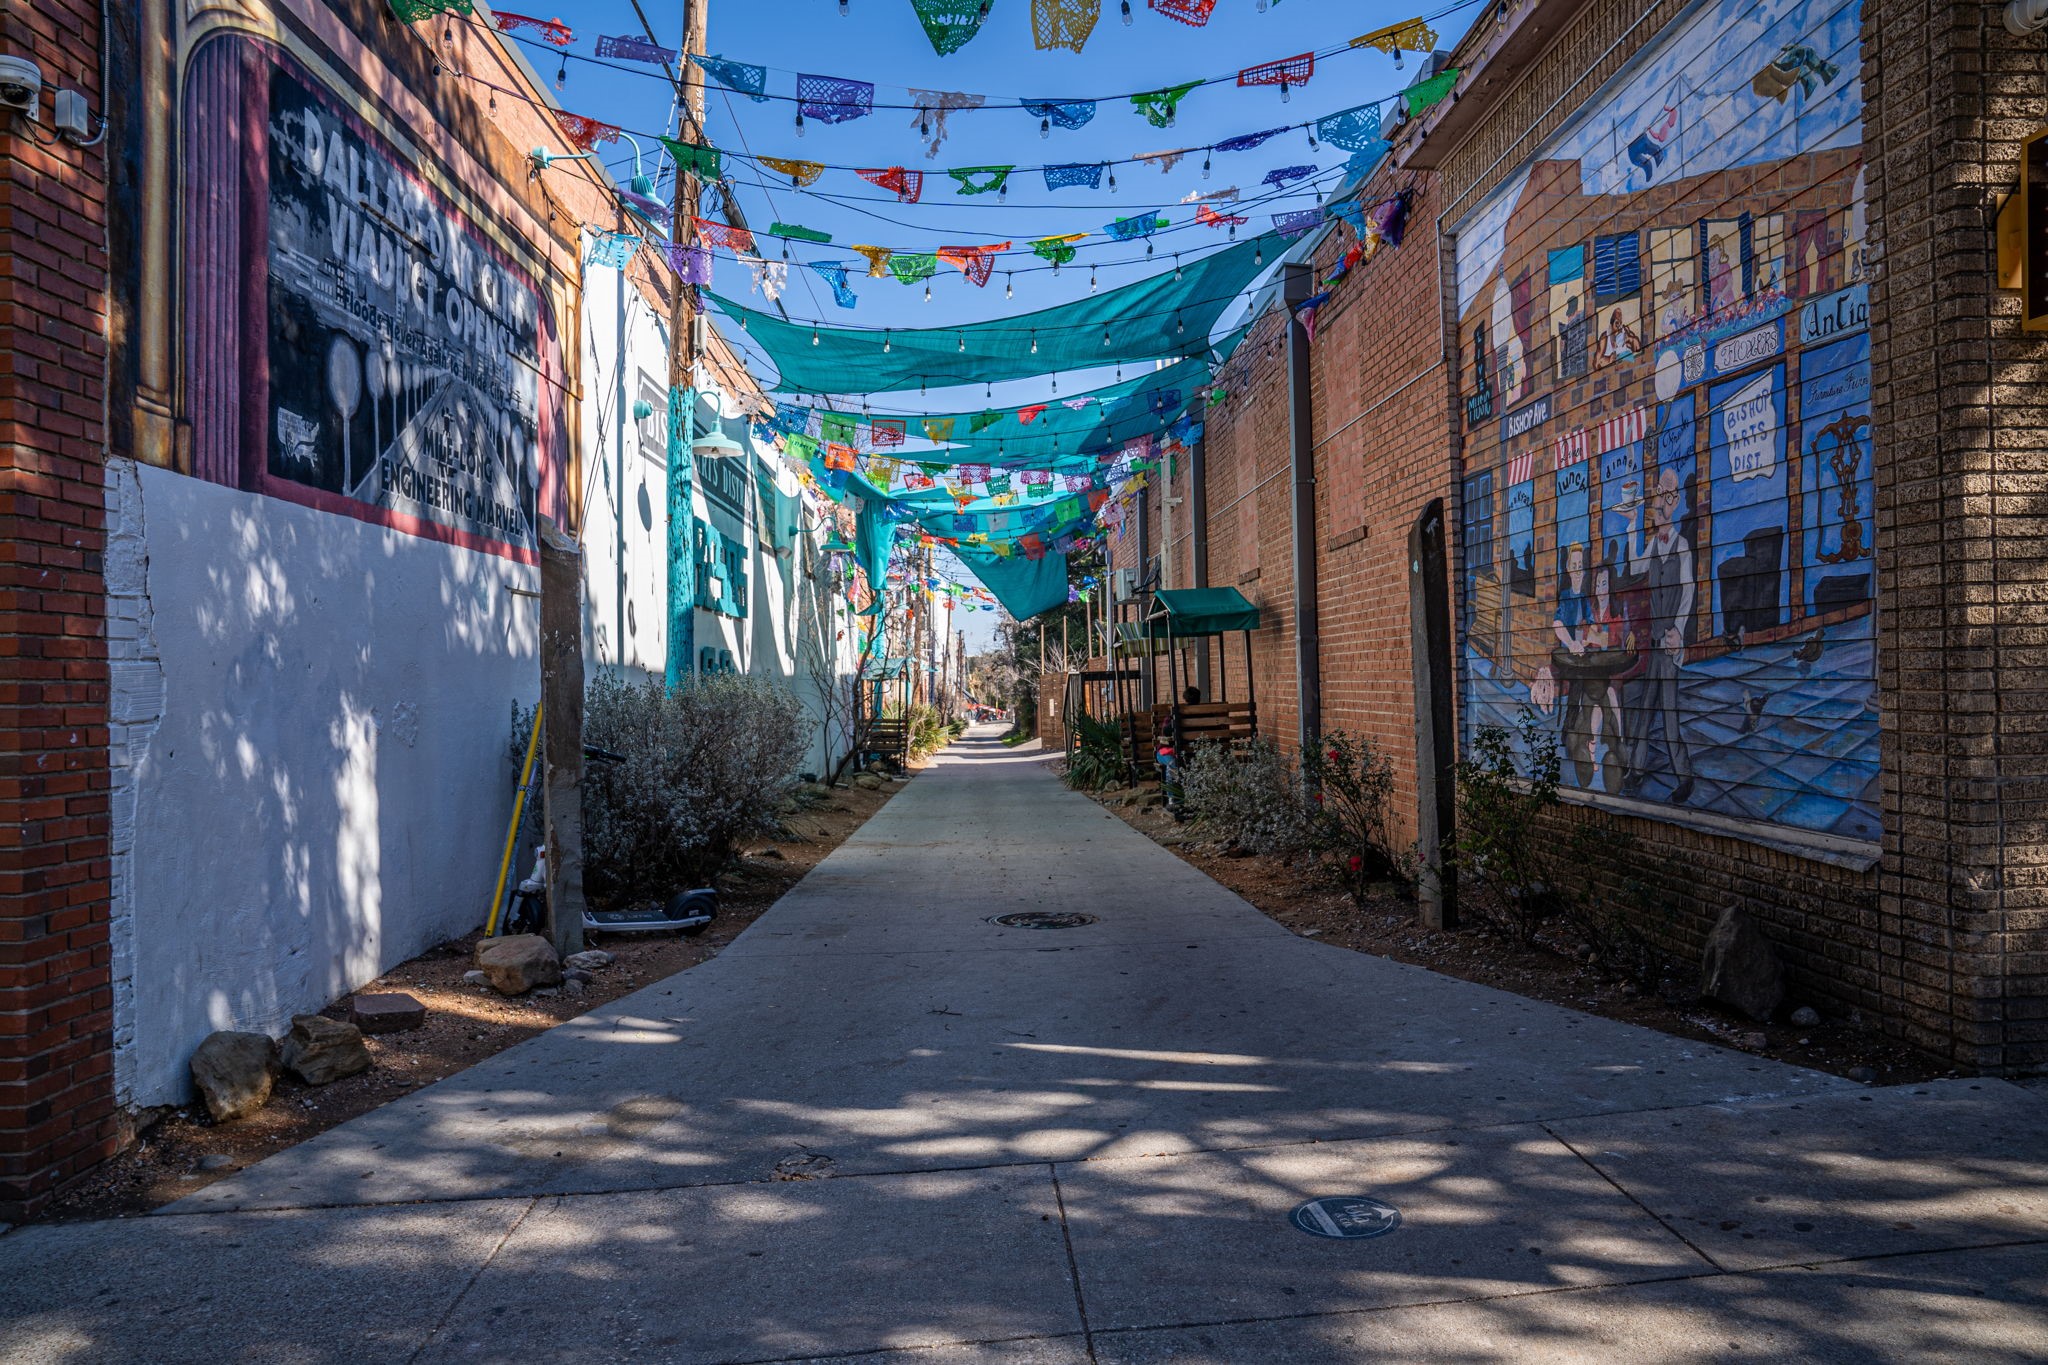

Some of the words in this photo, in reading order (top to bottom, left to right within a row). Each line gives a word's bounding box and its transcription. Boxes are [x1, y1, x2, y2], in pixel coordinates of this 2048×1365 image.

[327, 192, 437, 321] VIADUCT
[343, 285, 384, 331] Floods
[1476, 328, 1486, 391] LIVE
[1508, 409, 1534, 439] BISHOP
[1727, 387, 1771, 429] BISHOP
[1733, 420, 1768, 450] ARTS
[1734, 451, 1763, 472] DIST.
[382, 458, 472, 520] ENGINEERING
[477, 495, 523, 537] MARVEL!
